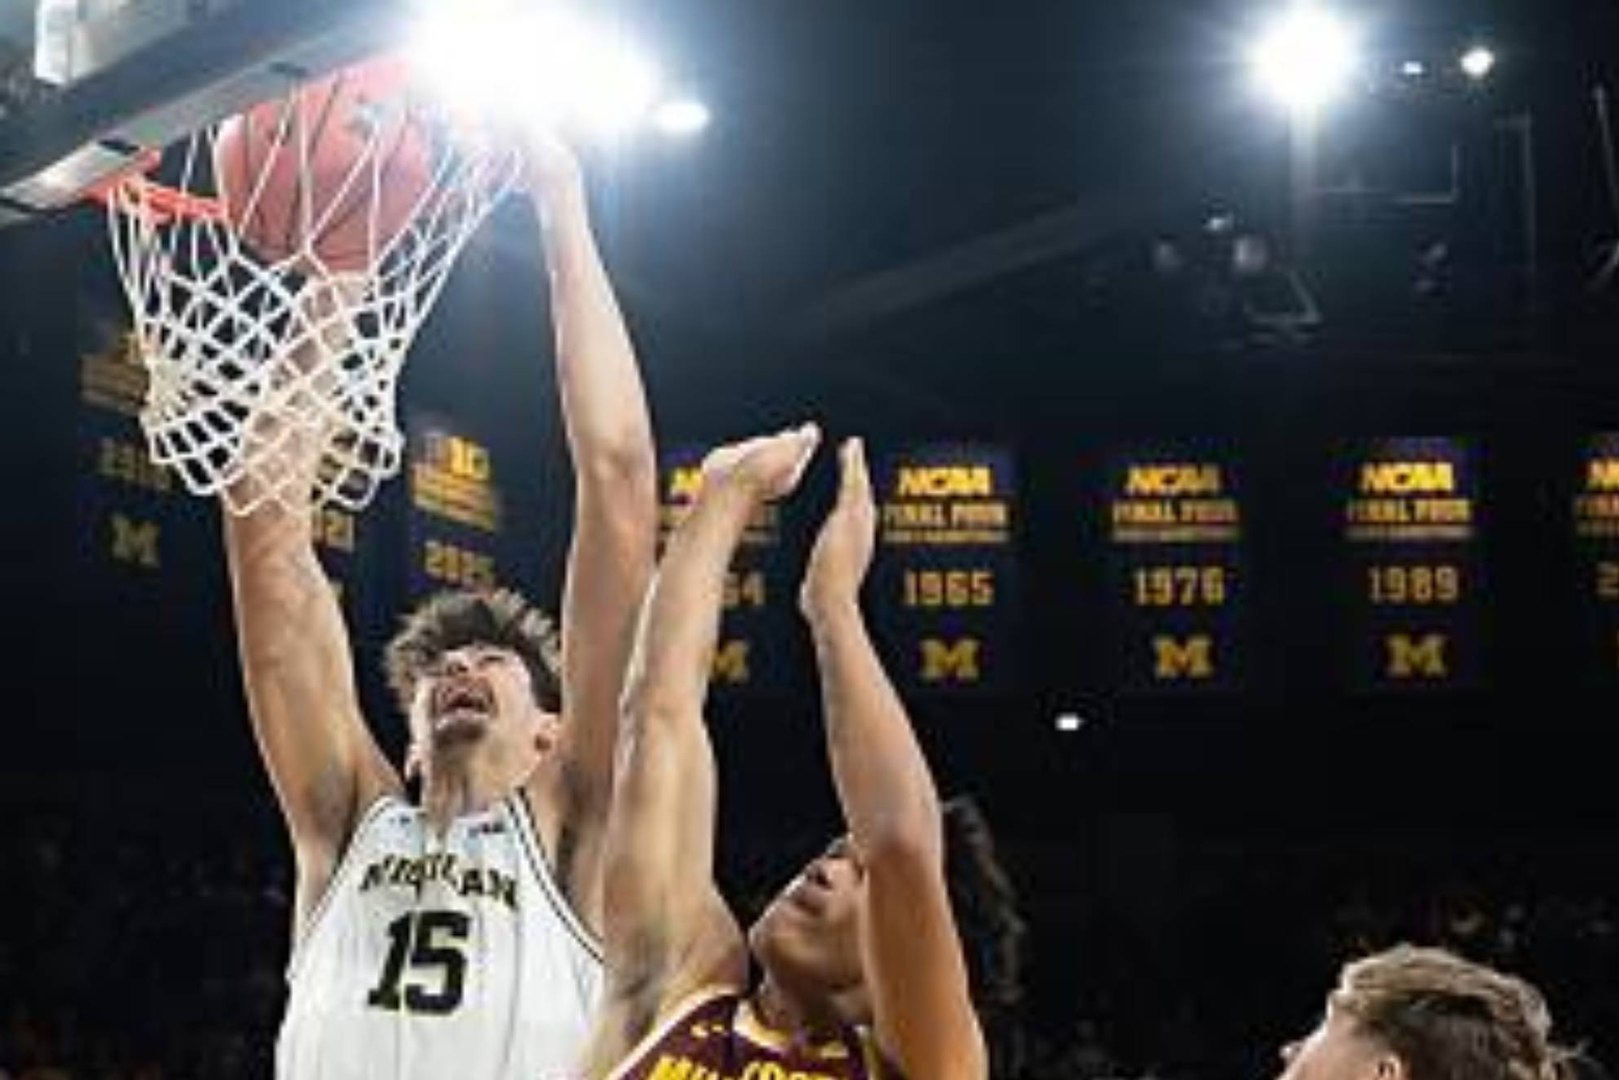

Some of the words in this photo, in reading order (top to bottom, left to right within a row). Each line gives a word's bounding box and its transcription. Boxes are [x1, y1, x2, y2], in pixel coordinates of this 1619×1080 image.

[898, 466, 991, 497] NCAA
[1127, 463, 1221, 496] NCAA
[1361, 462, 1454, 495] NCAA
[883, 502, 945, 527] FINAL
[1112, 500, 1176, 524] FINAL
[1347, 499, 1410, 524] FINAL
[904, 571, 993, 606] 1965
[1134, 567, 1224, 605] 1976
[1369, 567, 1458, 603] 1989
[920, 638, 980, 680] M
[1152, 637, 1213, 679] M
[1386, 635, 1446, 678] M
[367, 909, 470, 1017] 15
